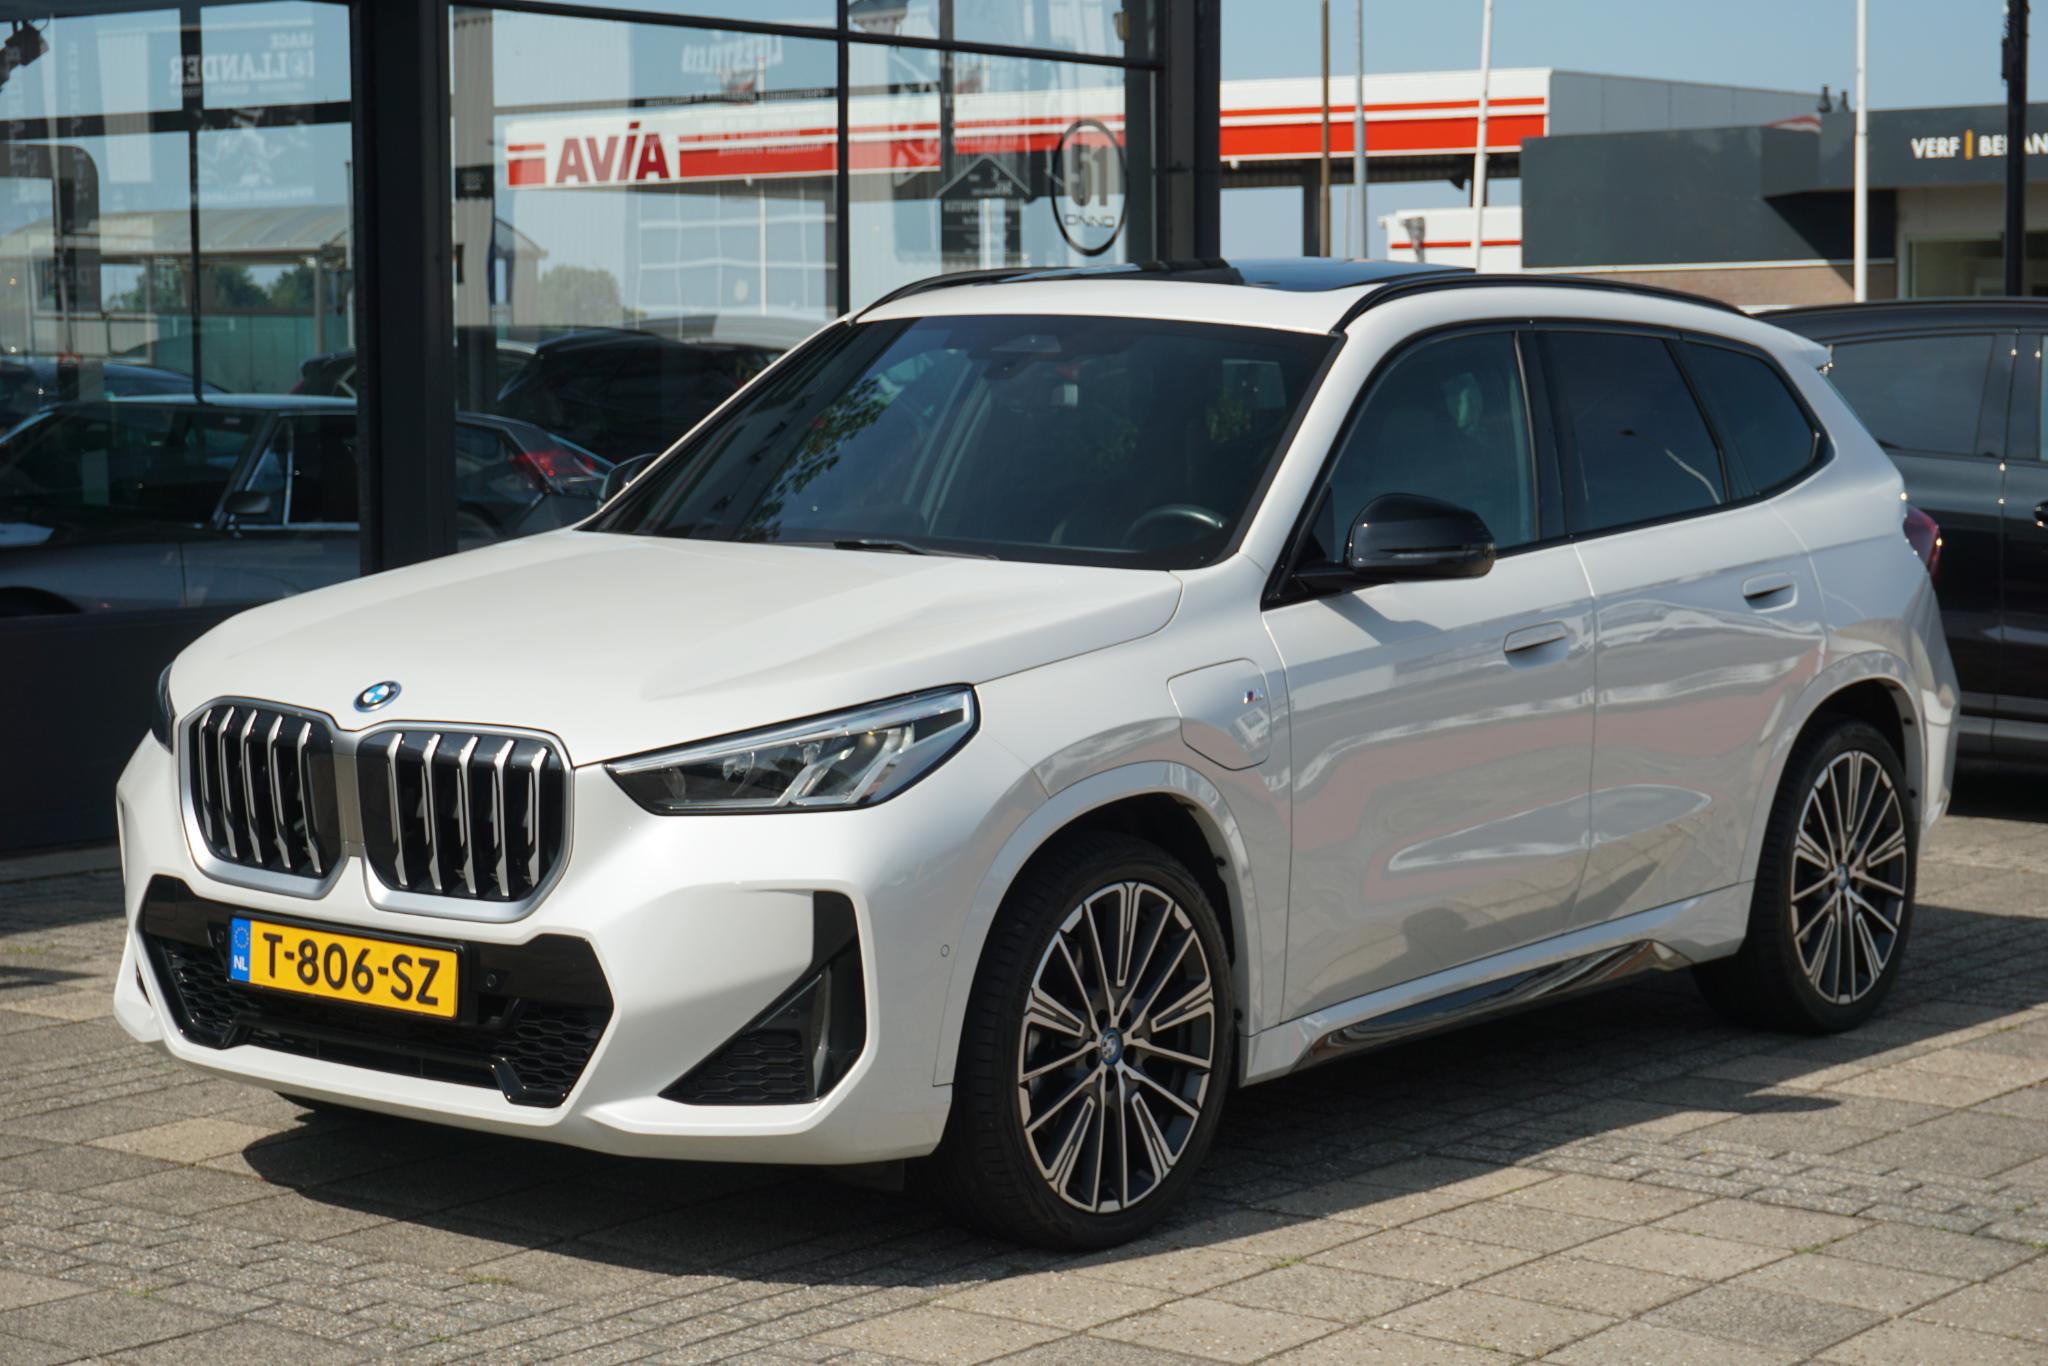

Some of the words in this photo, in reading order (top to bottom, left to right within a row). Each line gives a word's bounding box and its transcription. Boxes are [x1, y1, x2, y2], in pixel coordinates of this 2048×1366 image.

[1911, 136, 1960, 159] VERF
[1070, 143, 1108, 207] 51
[233, 955, 248, 972] NL
[263, 932, 440, 1006] T-806-SZ
